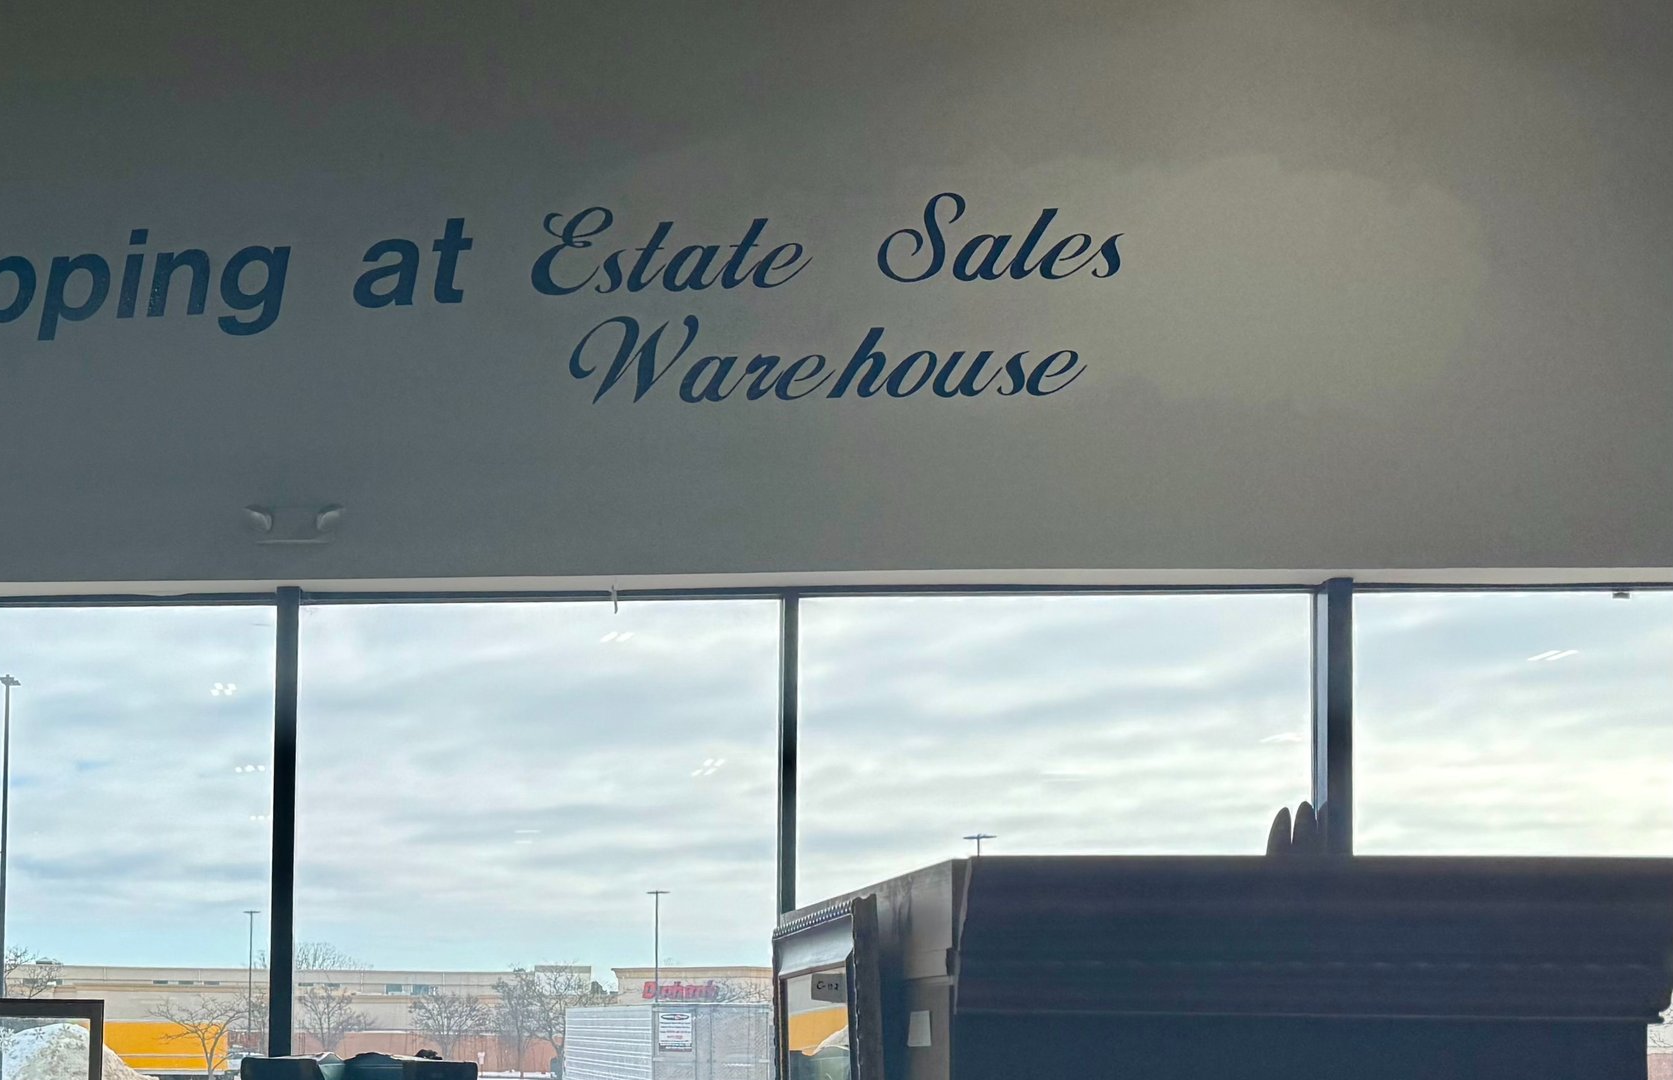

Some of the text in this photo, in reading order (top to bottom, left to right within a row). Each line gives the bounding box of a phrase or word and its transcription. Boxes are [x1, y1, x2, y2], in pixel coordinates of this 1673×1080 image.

[352, 217, 475, 309] at
[530, 206, 813, 296] Estate
[877, 192, 1125, 283] Sales
[568, 314, 1088, 405] Warehouse
